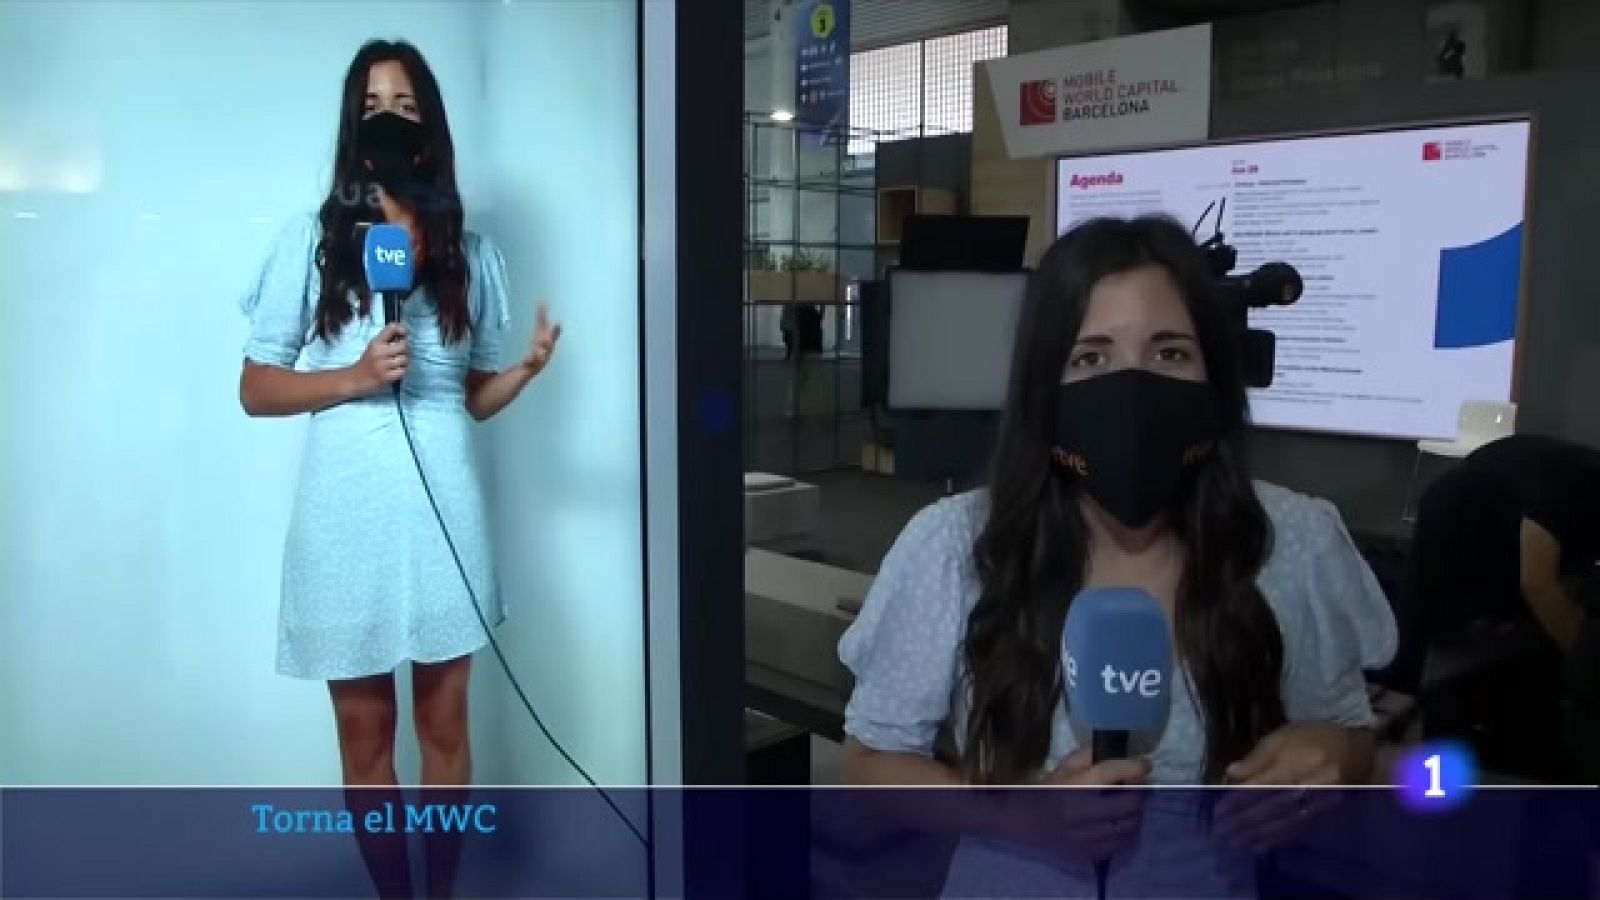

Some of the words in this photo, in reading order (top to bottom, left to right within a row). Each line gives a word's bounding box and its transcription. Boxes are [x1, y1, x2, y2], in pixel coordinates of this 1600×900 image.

[1063, 69, 1117, 88] MOBILE
[1063, 87, 1113, 106] WORLD
[1118, 79, 1178, 98] CAPITAL
[1063, 99, 1150, 121] BARCELONA
[1070, 171, 1123, 188] Agenda
[375, 245, 406, 266] tve
[1101, 664, 1161, 697] tve
